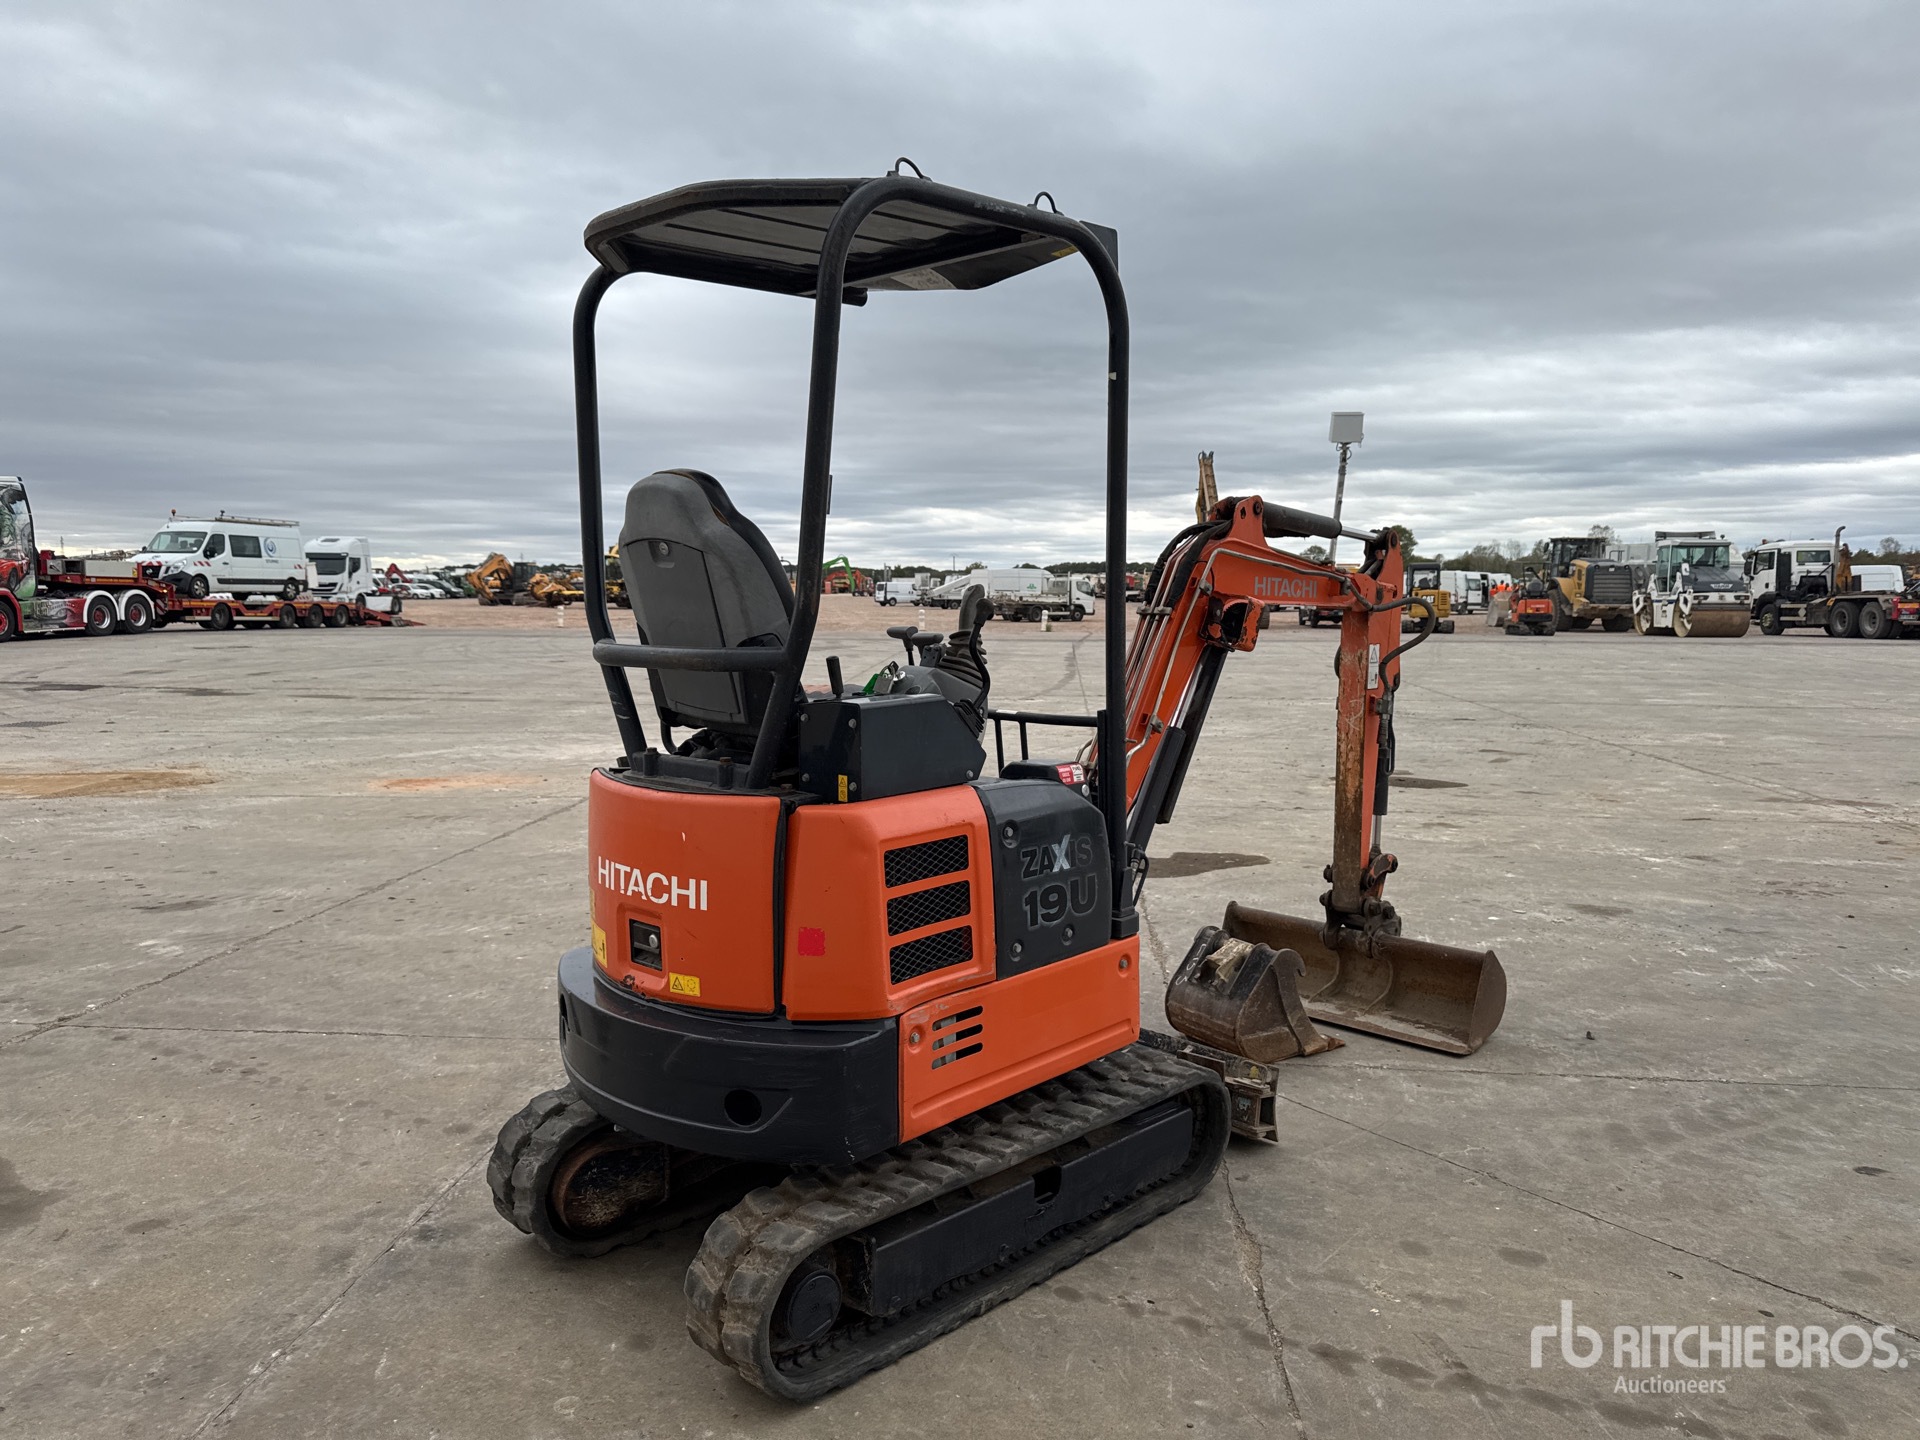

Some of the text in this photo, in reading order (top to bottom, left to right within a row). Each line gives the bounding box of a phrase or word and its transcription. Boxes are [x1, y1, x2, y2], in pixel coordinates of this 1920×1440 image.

[1254, 576, 1318, 598] HITACHI
[1021, 834, 1093, 879] ZAXIS
[598, 856, 708, 911] HITACHI
[1023, 874, 1098, 930] 19U
